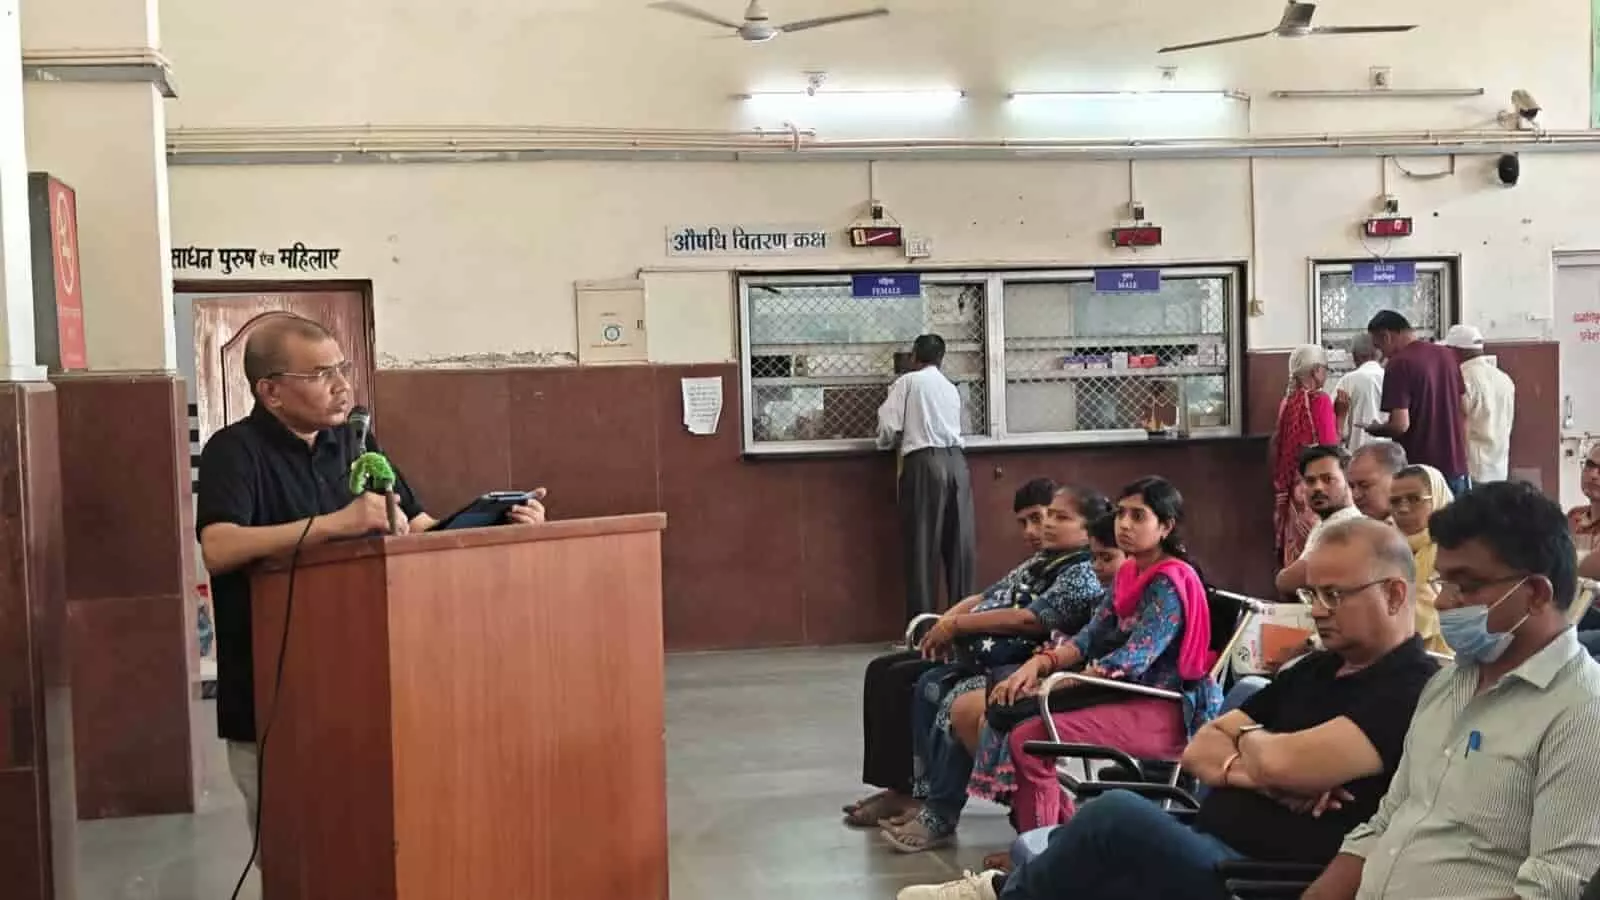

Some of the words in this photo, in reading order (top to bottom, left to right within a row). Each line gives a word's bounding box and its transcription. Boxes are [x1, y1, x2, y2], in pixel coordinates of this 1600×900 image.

[673, 227, 726, 251] औषधि
[732, 227, 787, 250] वितरण
[793, 231, 826, 249] कक्ष
[217, 248, 256, 274] पुरुष
[278, 242, 341, 272] महिलाए
[871, 287, 901, 295] FEMALE
[1117, 280, 1137, 289] MALE
